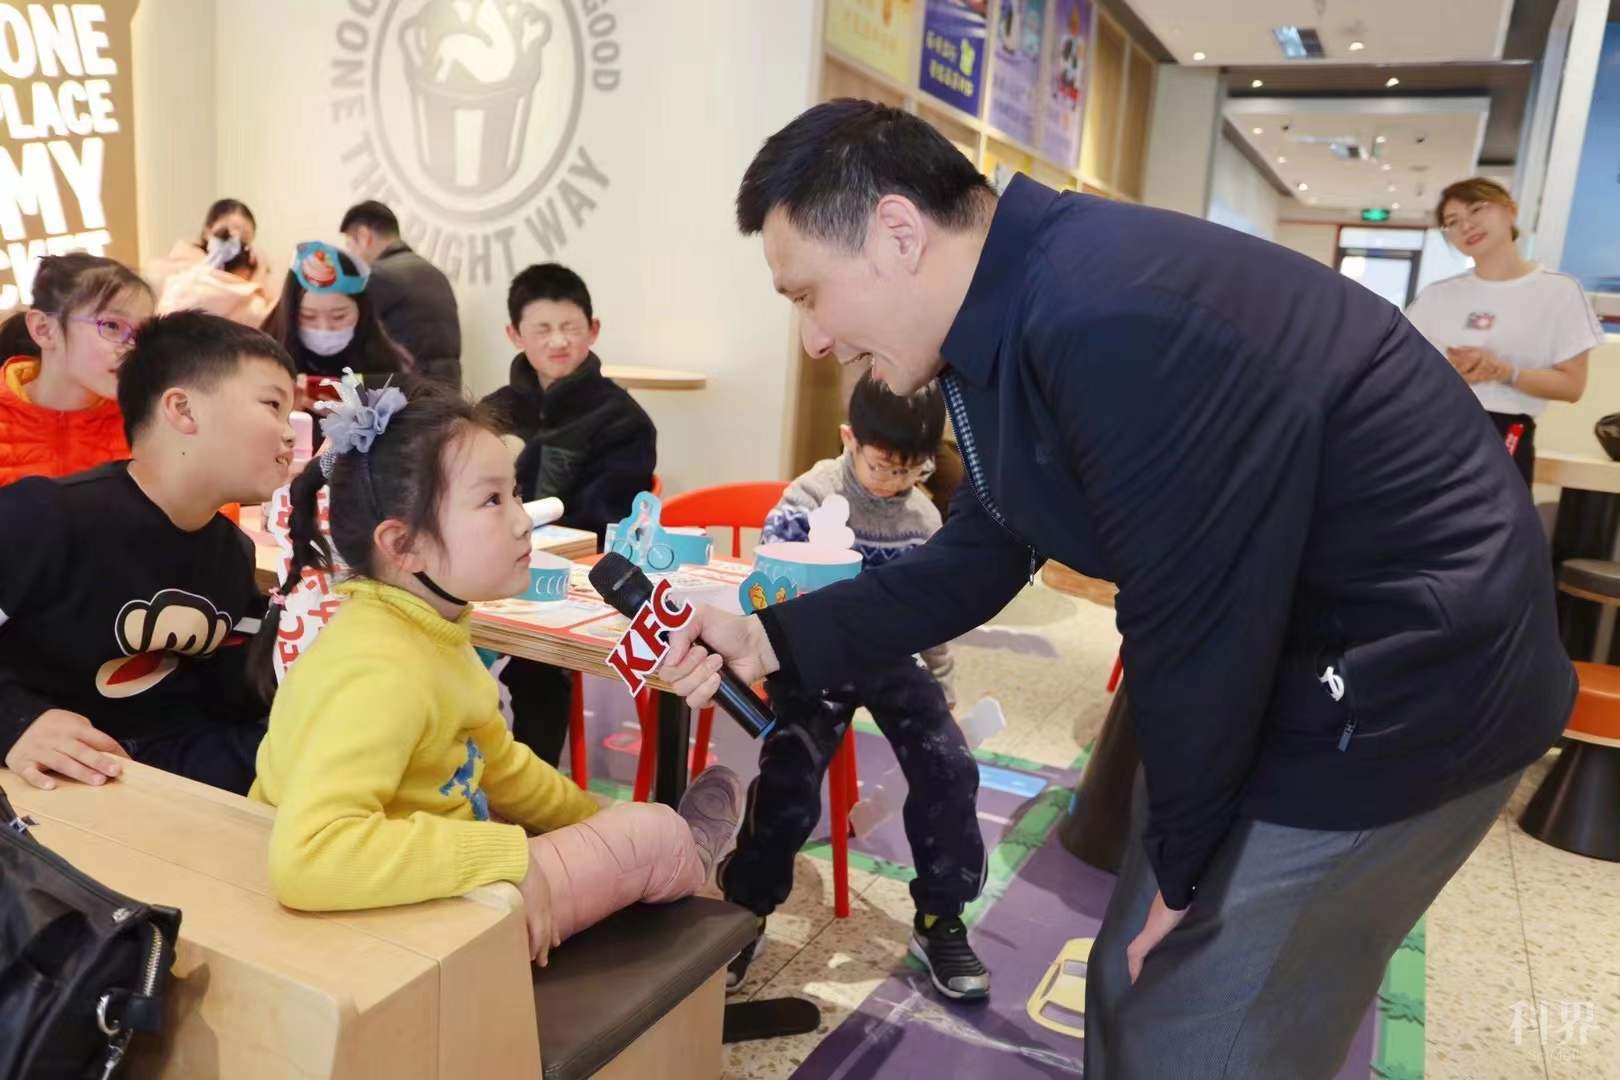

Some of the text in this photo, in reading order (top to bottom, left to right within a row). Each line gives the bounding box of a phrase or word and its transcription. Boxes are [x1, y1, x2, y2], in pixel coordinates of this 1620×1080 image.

[0, 3, 118, 78] ONE
[0, 78, 120, 139] LACE
[0, 137, 106, 241] MY
[524, 145, 611, 256] WAY
[605, 577, 696, 698] KFC
